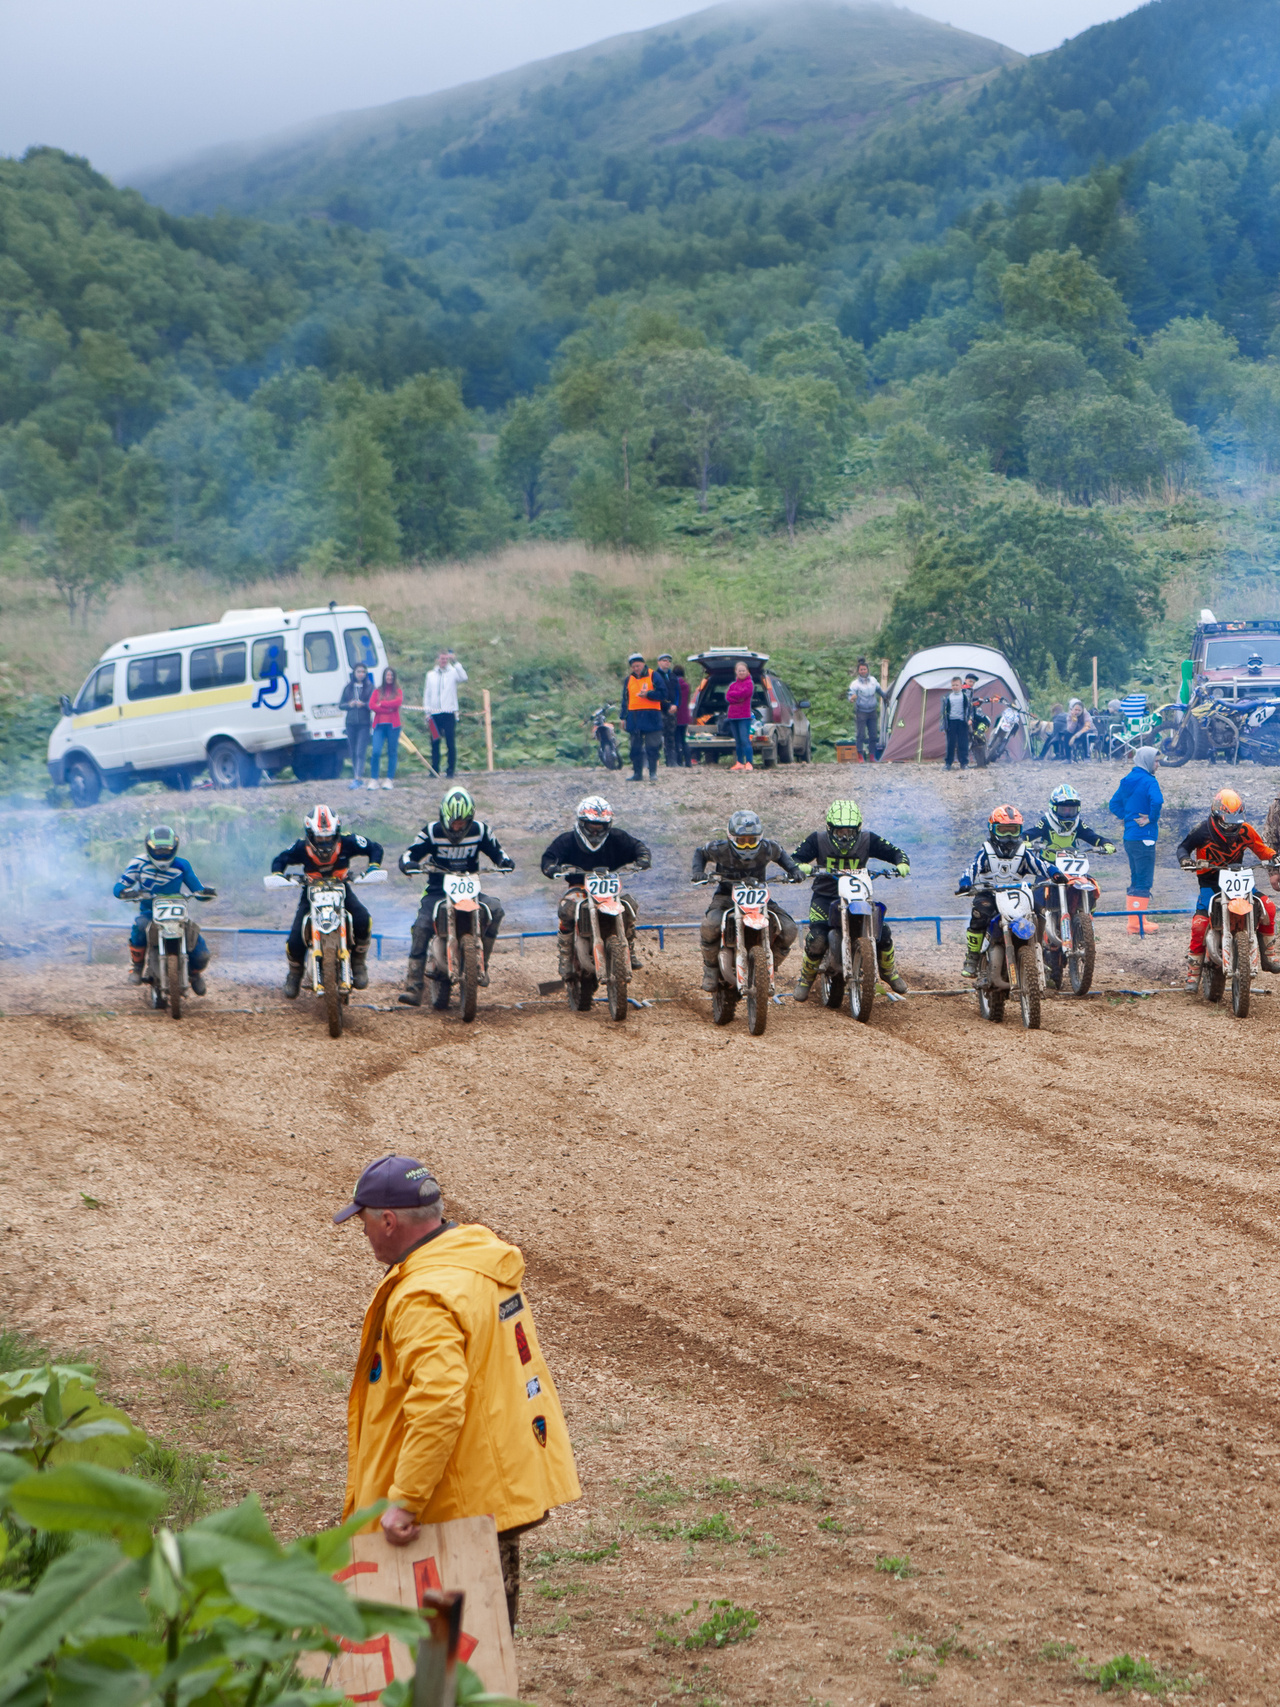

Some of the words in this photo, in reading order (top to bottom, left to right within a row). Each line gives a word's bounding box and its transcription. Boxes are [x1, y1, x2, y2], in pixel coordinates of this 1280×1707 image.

[1255, 708, 1267, 723] 27
[437, 844, 478, 860] SHIFT
[1063, 859, 1085, 872] 77
[450, 881, 475, 895] 208
[589, 879, 619, 895] 205
[1225, 878, 1250, 892] 207
[736, 889, 767, 906] 202
[156, 906, 185, 918] 70
